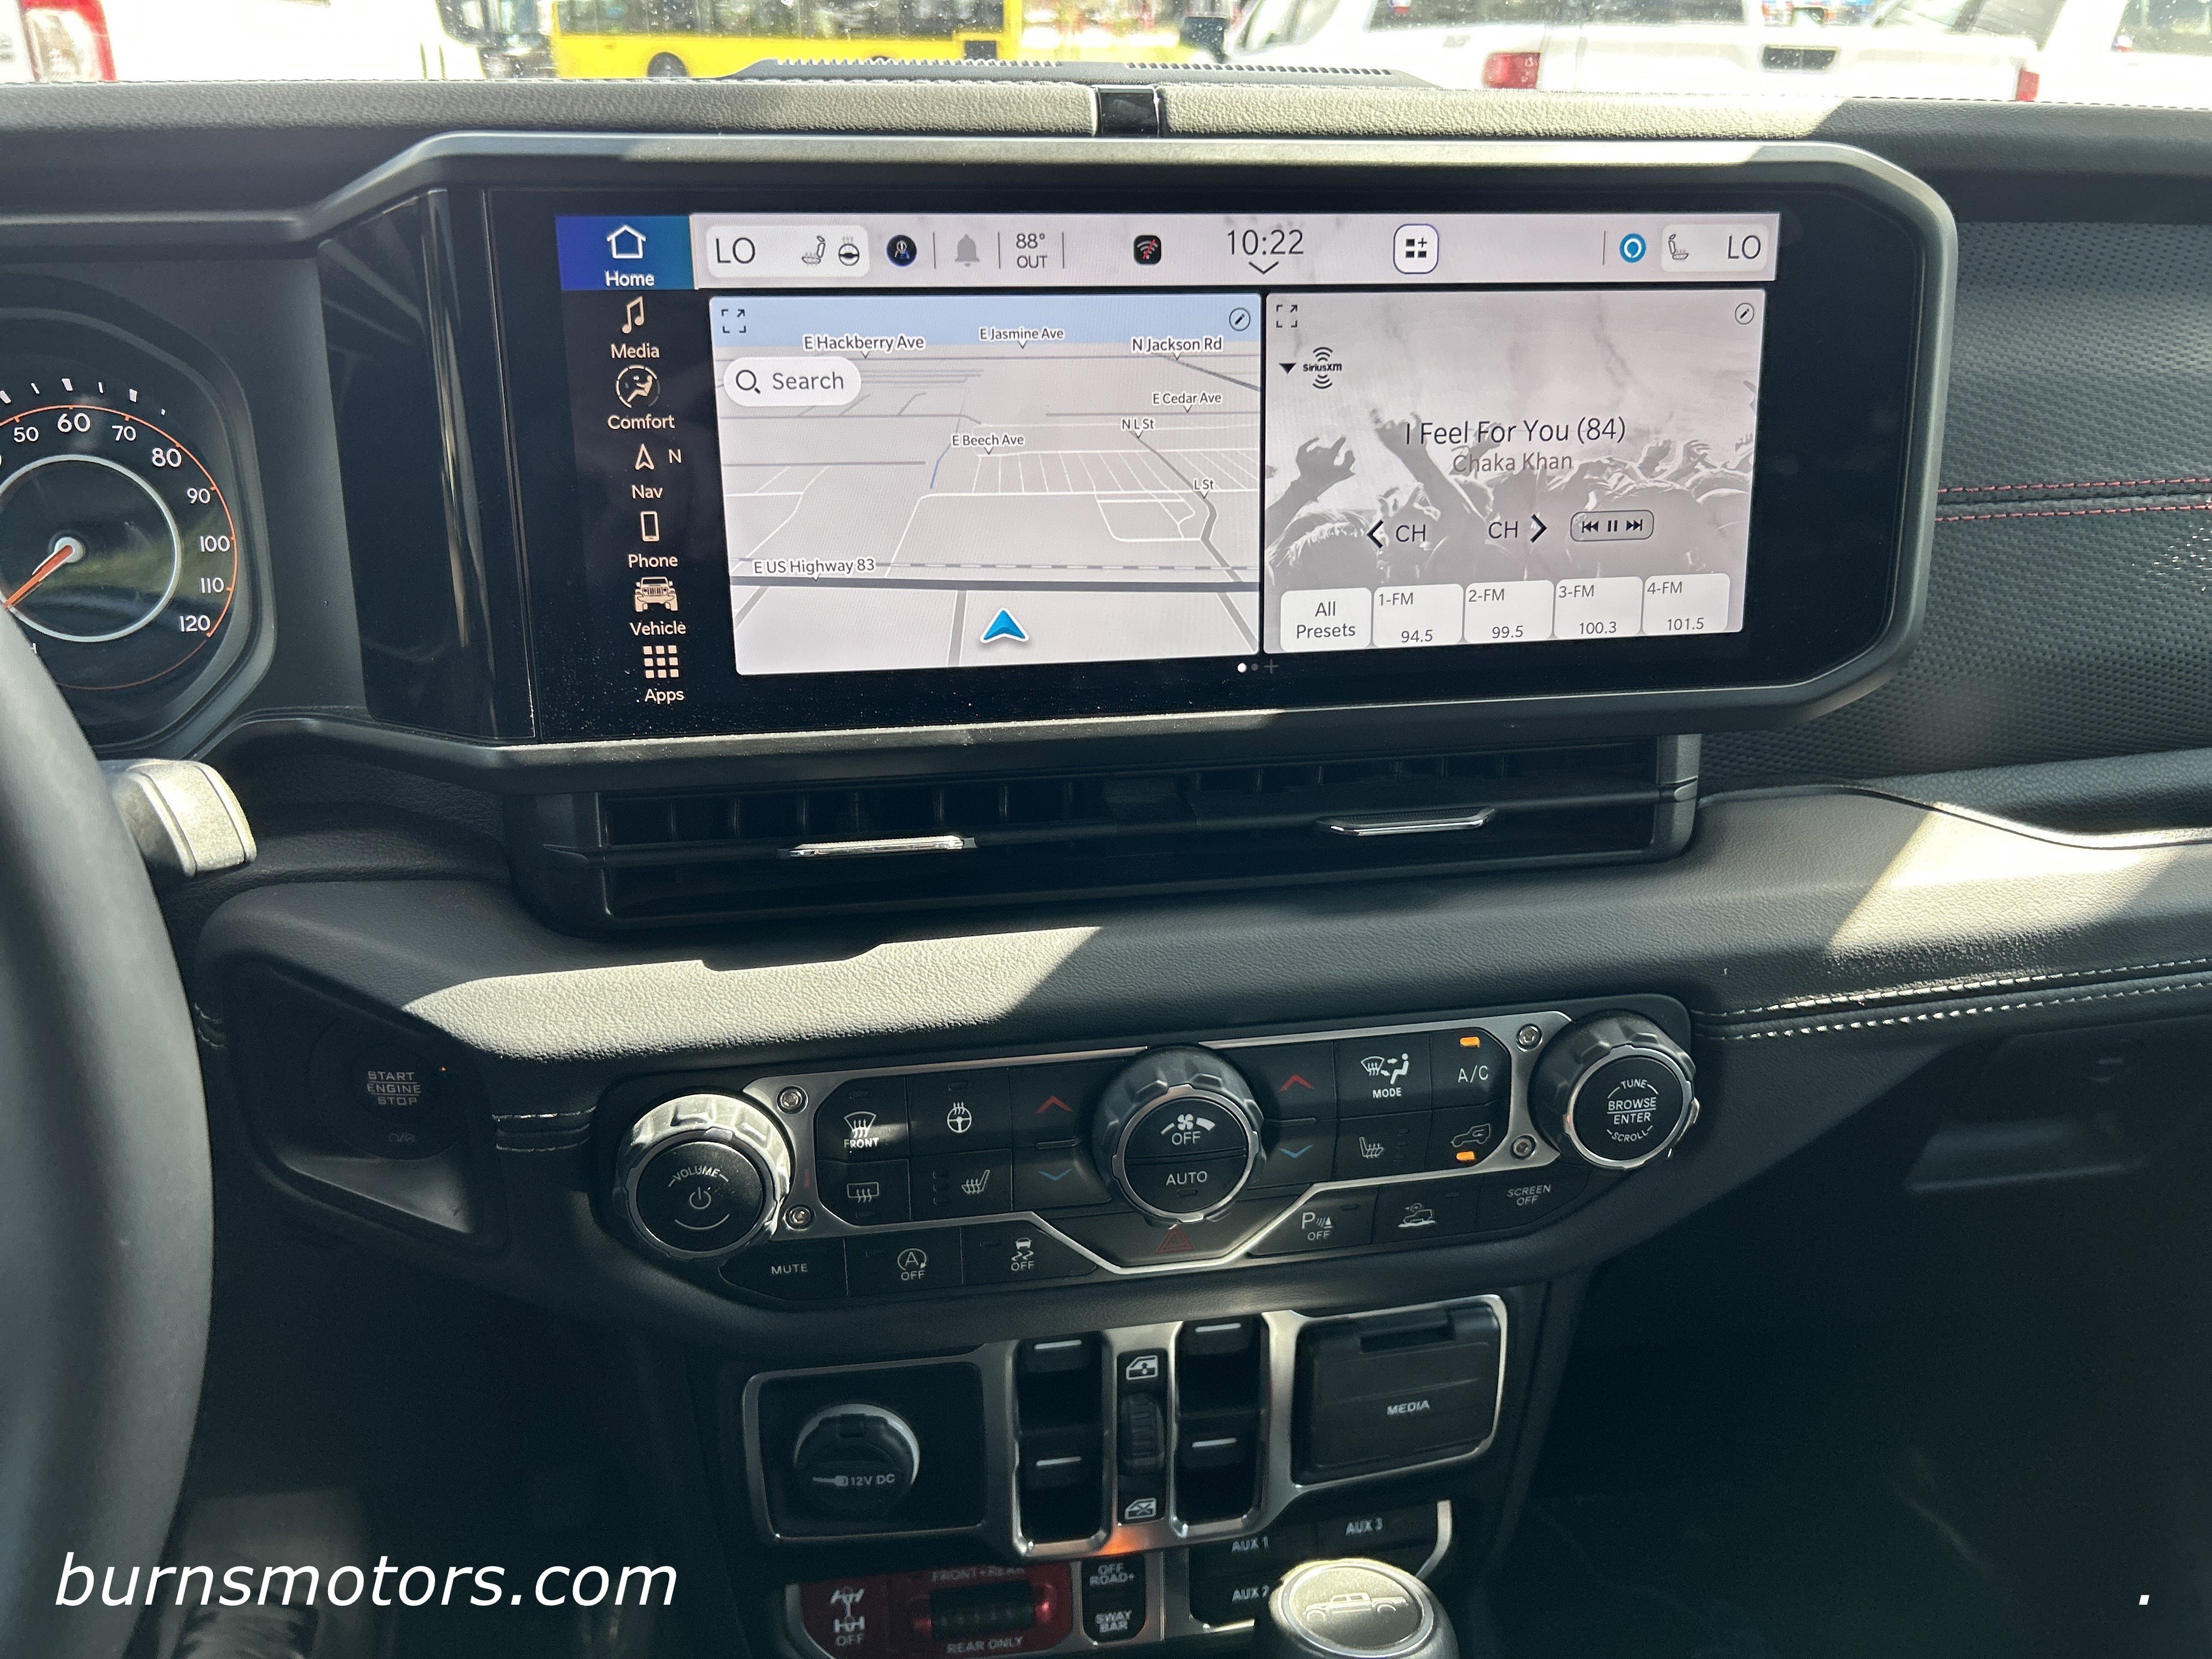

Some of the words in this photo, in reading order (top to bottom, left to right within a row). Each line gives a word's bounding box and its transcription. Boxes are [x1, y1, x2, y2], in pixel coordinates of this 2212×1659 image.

[1015, 233, 1046, 249] 88°
[1228, 229, 1304, 256] 10:22
[1728, 234, 1762, 261] LO
[716, 237, 755, 264] LO
[1017, 256, 1047, 269] OUT
[605, 271, 654, 287] Home
[980, 329, 987, 340] E
[990, 328, 1039, 340] Jasmine
[1042, 328, 1064, 339] Ave
[611, 343, 660, 359] Media
[804, 336, 813, 349] E
[817, 335, 894, 352] Hackberry
[897, 336, 924, 349] Ave
[1132, 338, 1143, 351] N
[1145, 338, 1200, 352] Jackson
[1204, 337, 1222, 351] Rd
[772, 372, 844, 391] Search
[1153, 393, 1160, 405] E
[1162, 393, 1197, 405] Cedar
[1199, 393, 1222, 404] Ave
[57, 413, 91, 432] 60
[607, 415, 675, 430] Comfort
[1122, 419, 1131, 430] N
[1134, 419, 1139, 430] L
[1142, 419, 1154, 430] St
[13, 427, 40, 443] 50
[111, 425, 137, 442] 70
[1406, 423, 1410, 445] I
[1421, 421, 1469, 445] Feel
[1477, 420, 1517, 443] For
[1522, 419, 1570, 442] You
[1578, 416, 1626, 444] (84)
[952, 435, 960, 446] E
[963, 434, 999, 446] Beech
[1002, 435, 1024, 445] Ave
[151, 448, 182, 467] 80
[669, 449, 682, 463] N
[1453, 453, 1516, 474] Chaka
[1522, 452, 1572, 472] Khan
[631, 485, 663, 499] Nav
[1194, 479, 1200, 490] L
[1202, 479, 1214, 490] St
[187, 488, 211, 504] 90
[1395, 525, 1426, 544] CH
[1488, 521, 1519, 540] CH
[200, 535, 230, 552] 100
[628, 554, 678, 568] Phone
[754, 561, 763, 574] E
[766, 560, 787, 573] US
[789, 559, 854, 577] Highway
[856, 558, 875, 572] 83
[201, 577, 225, 594] 110
[1558, 585, 1595, 599] 3-FM
[1646, 581, 1683, 595] 4-FM
[1379, 592, 1414, 606] 1-FM
[1468, 589, 1505, 603] 2-FM
[1314, 601, 1336, 617] All
[179, 615, 211, 632] 120
[630, 621, 686, 636] Vehicle
[1296, 622, 1356, 639] Presets
[1578, 620, 1617, 635] 100.3
[1667, 617, 1705, 631] 101.5
[1401, 629, 1434, 644] 94.5
[1491, 625, 1524, 640] 99.5
[645, 689, 685, 704] Apps
[368, 1070, 415, 1081] START
[1457, 1065, 1489, 1084] A/C
[367, 1083, 421, 1093] ENGINE
[1621, 1079, 1647, 1090] TUNE
[1372, 1087, 1402, 1098] MODE
[378, 1097, 417, 1105] STOP
[1608, 1097, 1657, 1111] BROWSE
[1613, 1112, 1651, 1125] ENTER
[843, 1137, 879, 1149] FRONT
[1171, 1131, 1201, 1146] OFF
[1611, 1130, 1649, 1142] SCROLL
[673, 1165, 721, 1181] VOLUME
[1166, 1170, 1207, 1186] AUTO
[1507, 1184, 1551, 1198] SCREEN
[1517, 1194, 1539, 1206] OFF
[1307, 1231, 1330, 1241] OFF
[771, 1263, 809, 1275] MUTE
[1011, 1260, 1035, 1271] OFF
[900, 1269, 926, 1280] OFF
[1387, 1400, 1431, 1415] MEDIA
[850, 1476, 873, 1486] 12V
[876, 1474, 895, 1485] DC
[1346, 1520, 1373, 1536] AUX
[1375, 1517, 1383, 1531] 3
[1232, 1537, 1260, 1554] AUX
[1263, 1536, 1269, 1548] 1
[1098, 1564, 1124, 1576] OFF
[1232, 1587, 1259, 1602] AUX
[1094, 1609, 1132, 1624] SWAY
[1099, 1620, 1128, 1633] BAR
[835, 1633, 865, 1646] OFF
[946, 1642, 985, 1654] REAR
[987, 1636, 1023, 1649] ONLY
